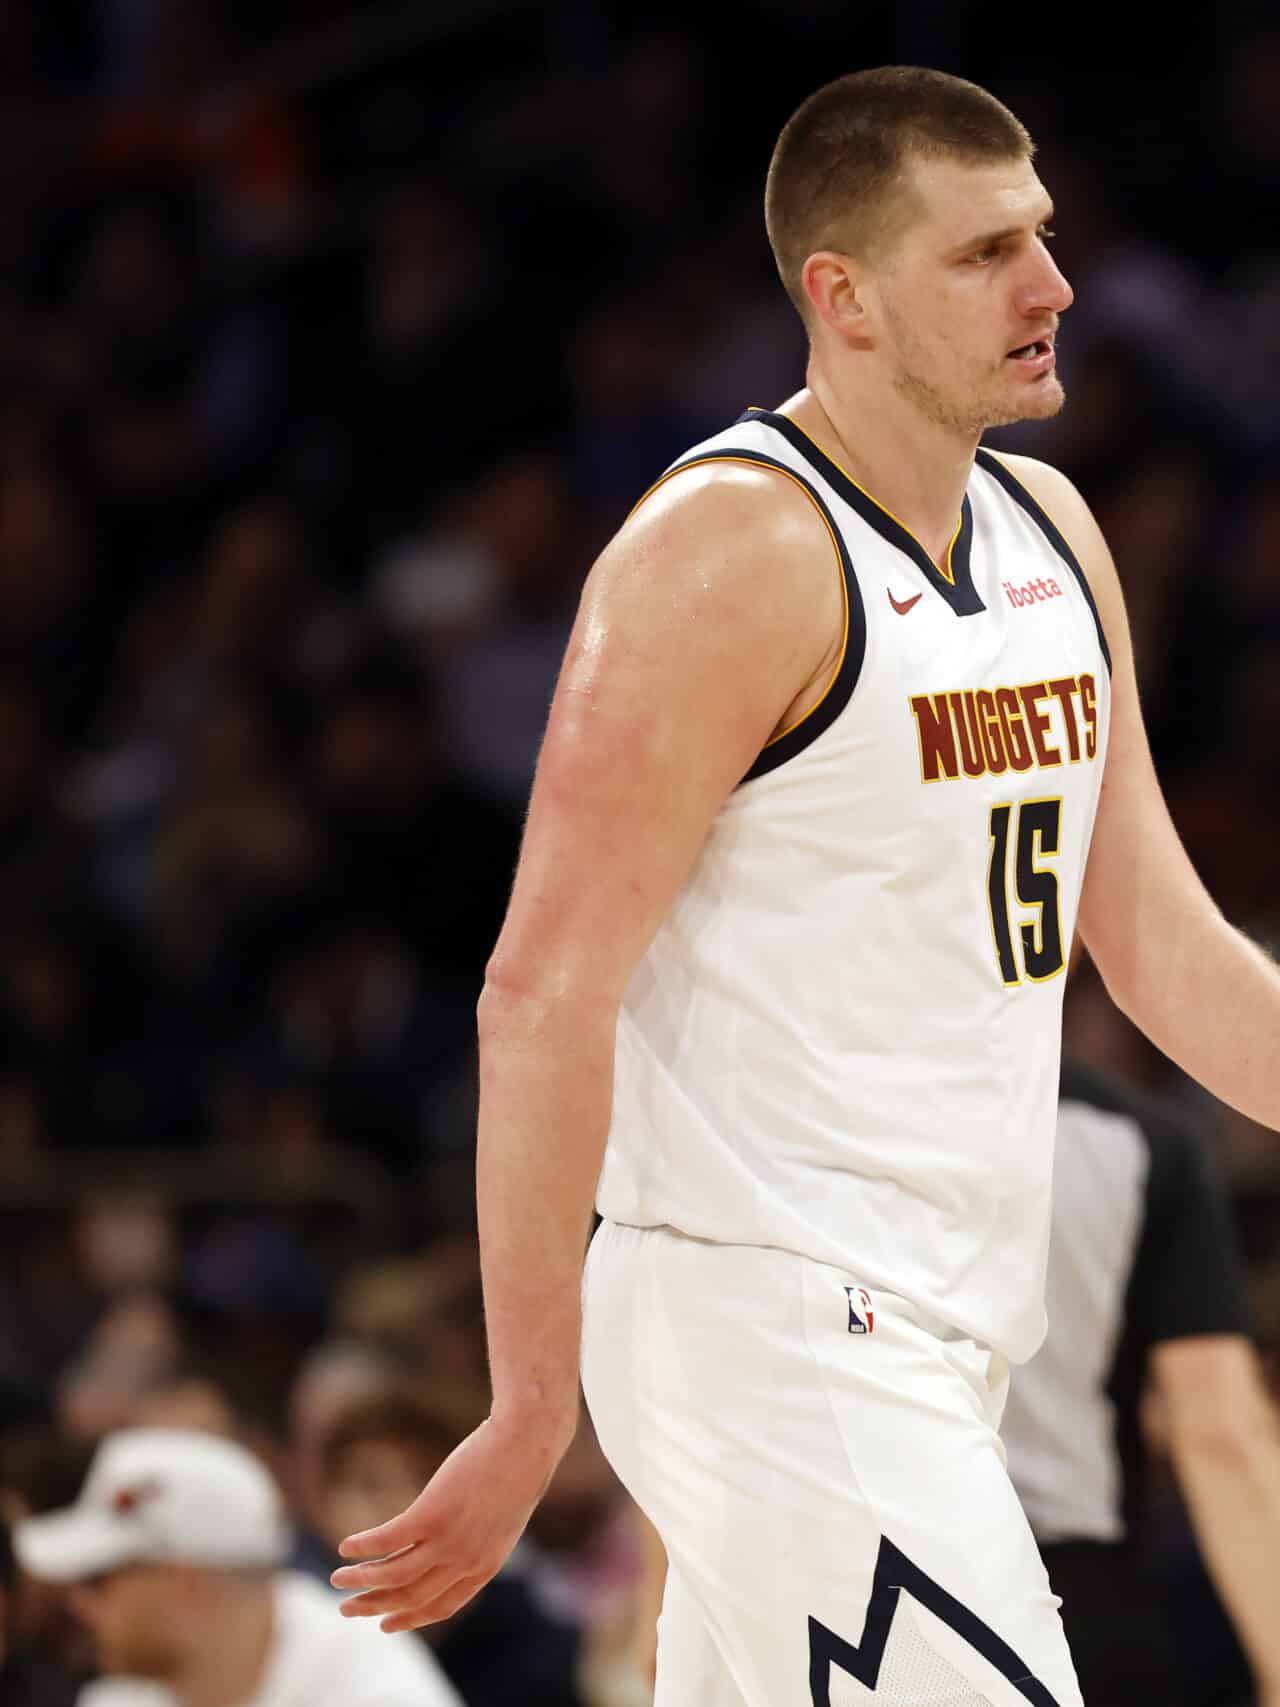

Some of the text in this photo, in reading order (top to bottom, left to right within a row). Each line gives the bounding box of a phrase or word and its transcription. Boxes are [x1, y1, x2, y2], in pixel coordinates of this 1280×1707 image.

[1003, 577, 1063, 609] ibotta
[908, 672, 1098, 785] NUGGETS
[986, 795, 1065, 988] 15
